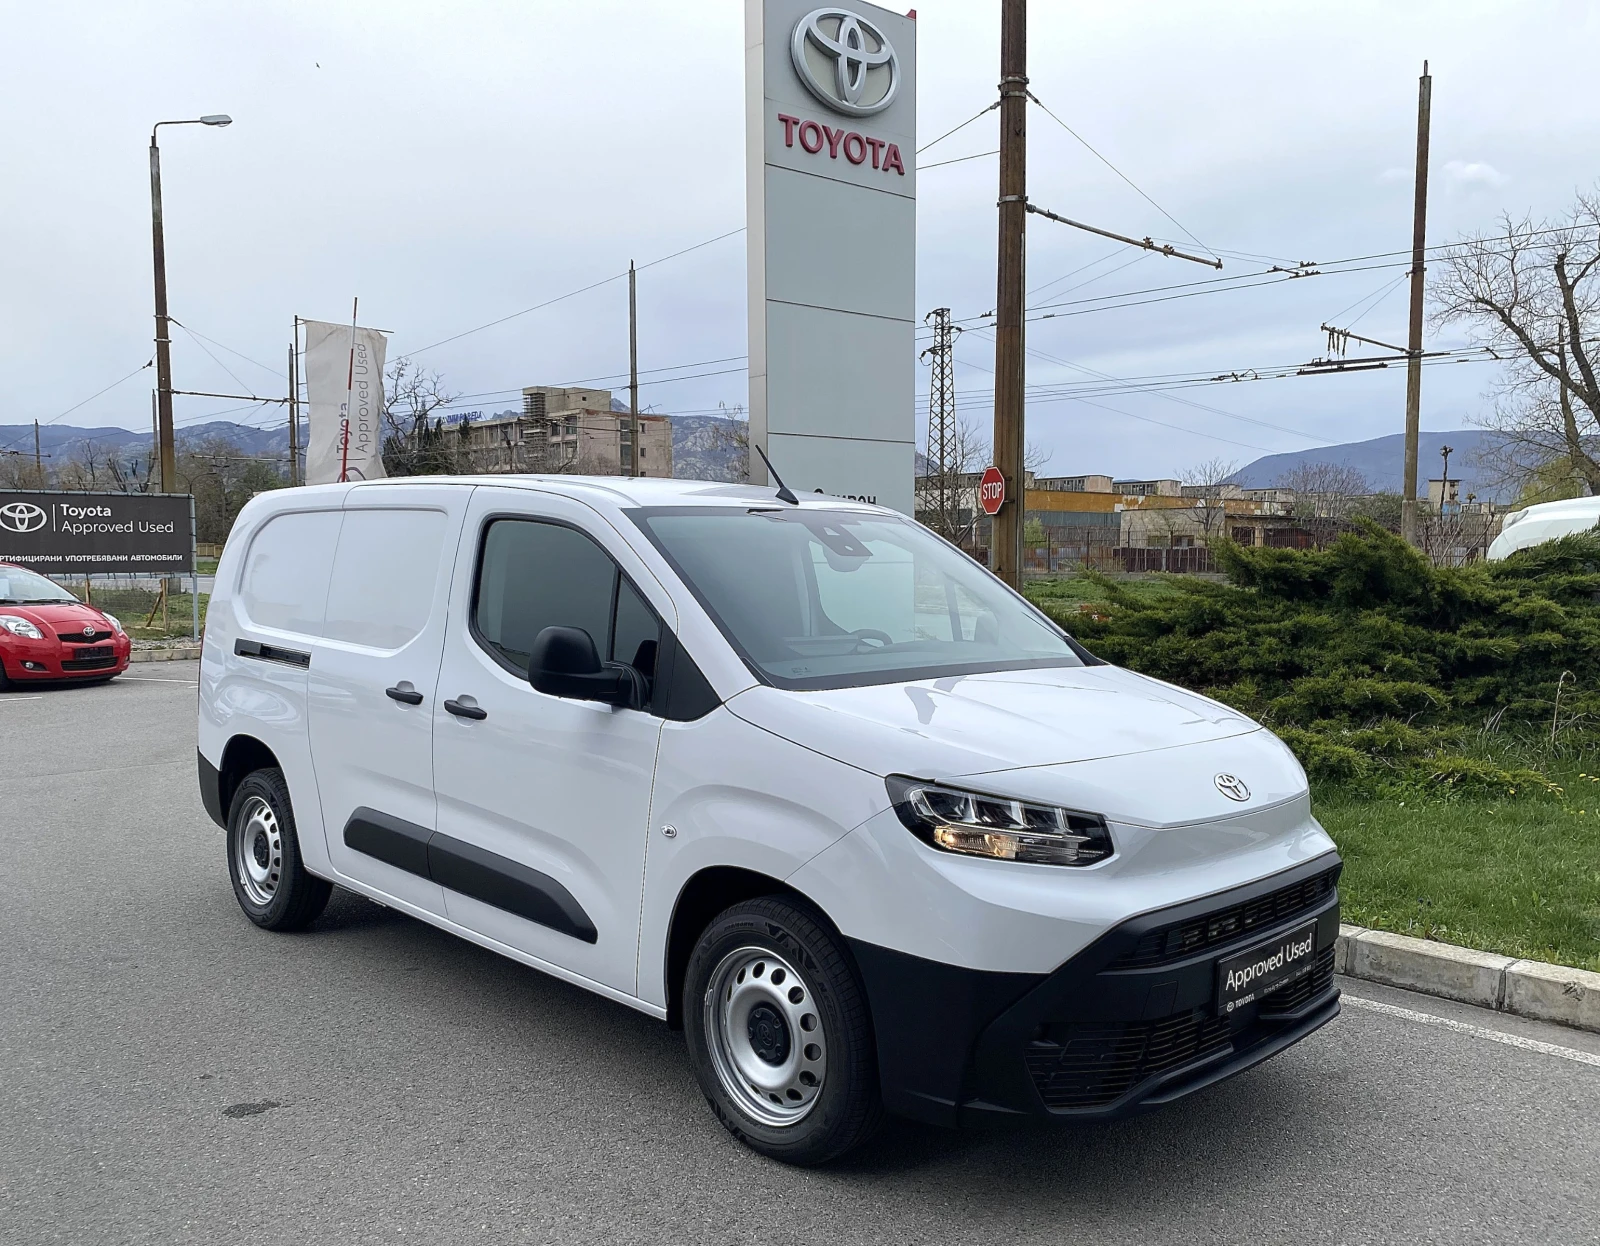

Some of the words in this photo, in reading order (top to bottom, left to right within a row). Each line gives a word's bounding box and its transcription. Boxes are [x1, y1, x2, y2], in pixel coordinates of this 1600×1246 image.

[778, 113, 905, 175] TOYOTA
[355, 343, 368, 375] Used
[356, 381, 371, 453] Approved
[982, 482, 1002, 500] STOP
[60, 503, 112, 519] Toyota
[61, 521, 133, 535] Approved
[138, 521, 174, 533] Used
[65, 554, 128, 562] УПОТРЕБЯВАНИ
[130, 554, 183, 562] АВТОМОБИЛИ
[1225, 946, 1284, 991] Approved
[1286, 932, 1312, 962] Used
